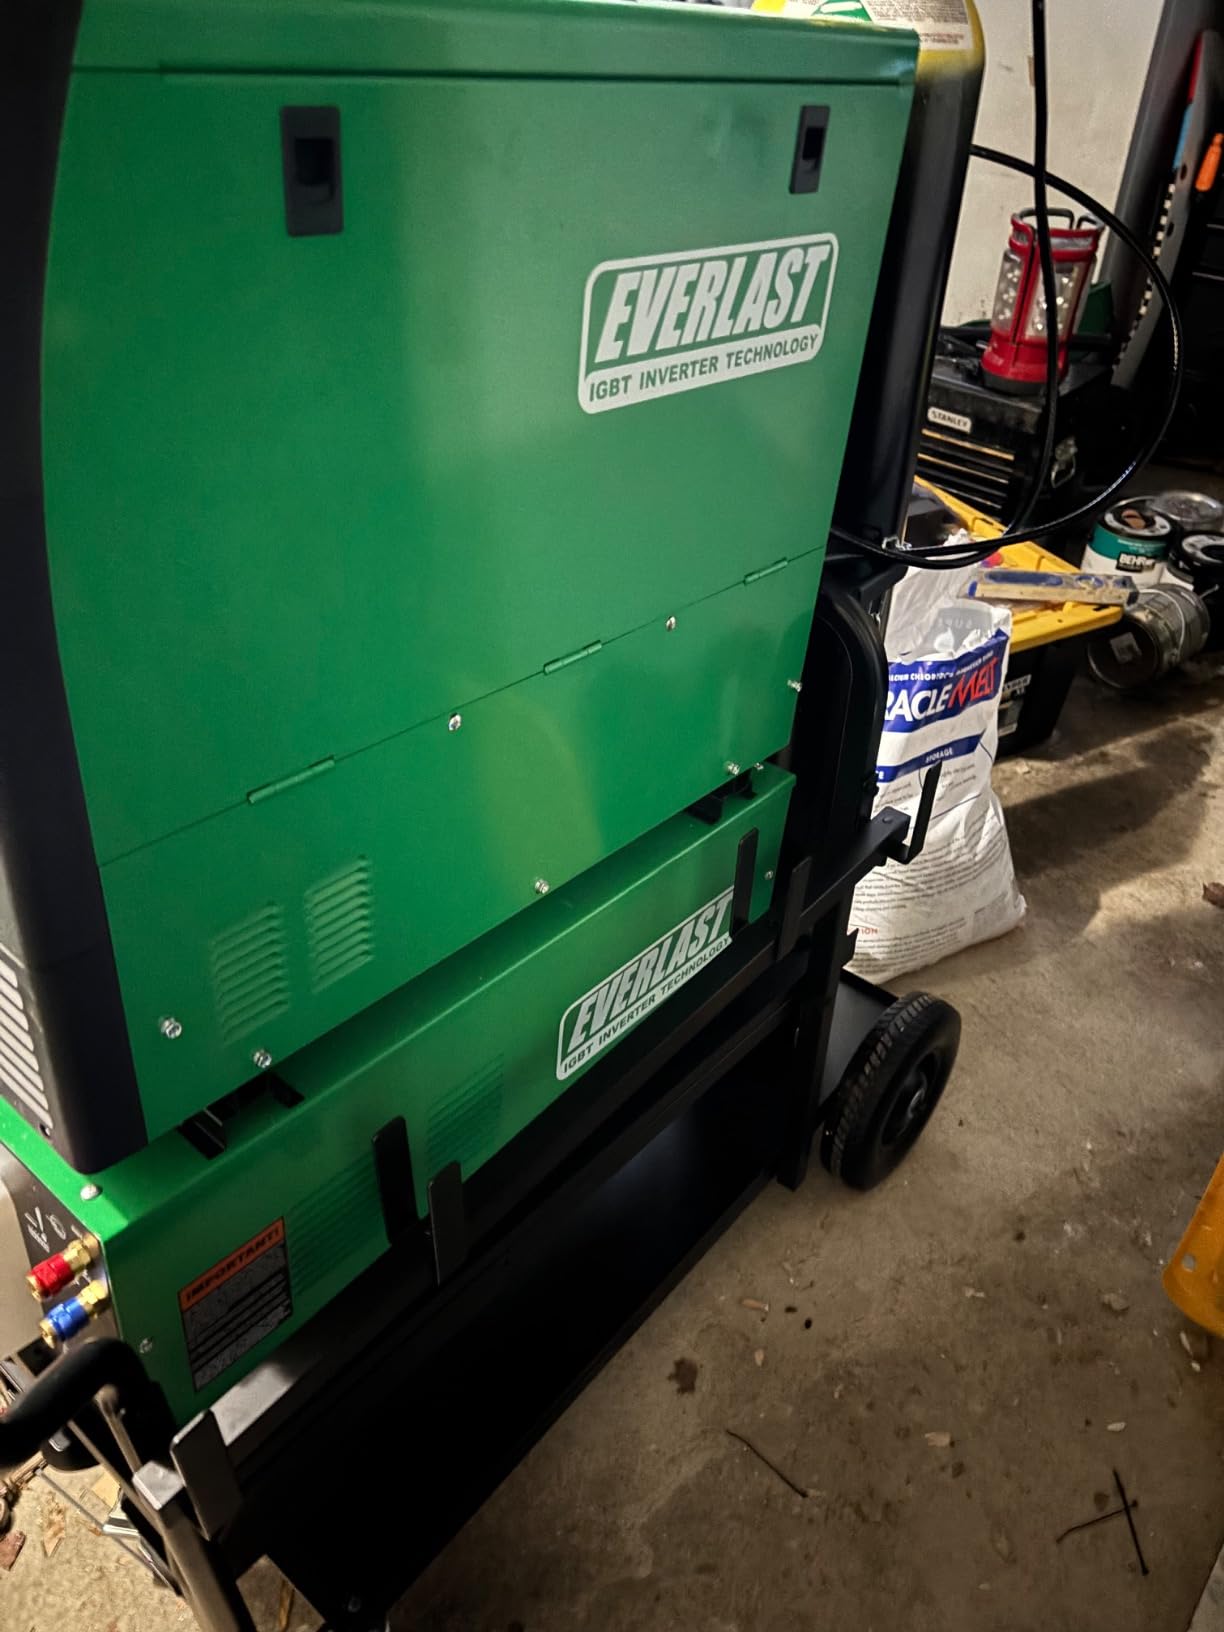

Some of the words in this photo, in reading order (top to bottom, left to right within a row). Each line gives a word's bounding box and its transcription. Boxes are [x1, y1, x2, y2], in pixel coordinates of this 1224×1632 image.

[595, 244, 831, 363] EVERLAST
[590, 375, 632, 402] IGBT
[639, 356, 718, 390] INVERTER
[726, 334, 819, 370] TECHNOLOGY
[931, 410, 968, 428] STANLEY
[564, 1043, 593, 1073] IGBT
[600, 995, 656, 1044] INVERTER
[661, 937, 730, 996] TECHNOLOGY
[567, 890, 734, 1053] EVERLAST
